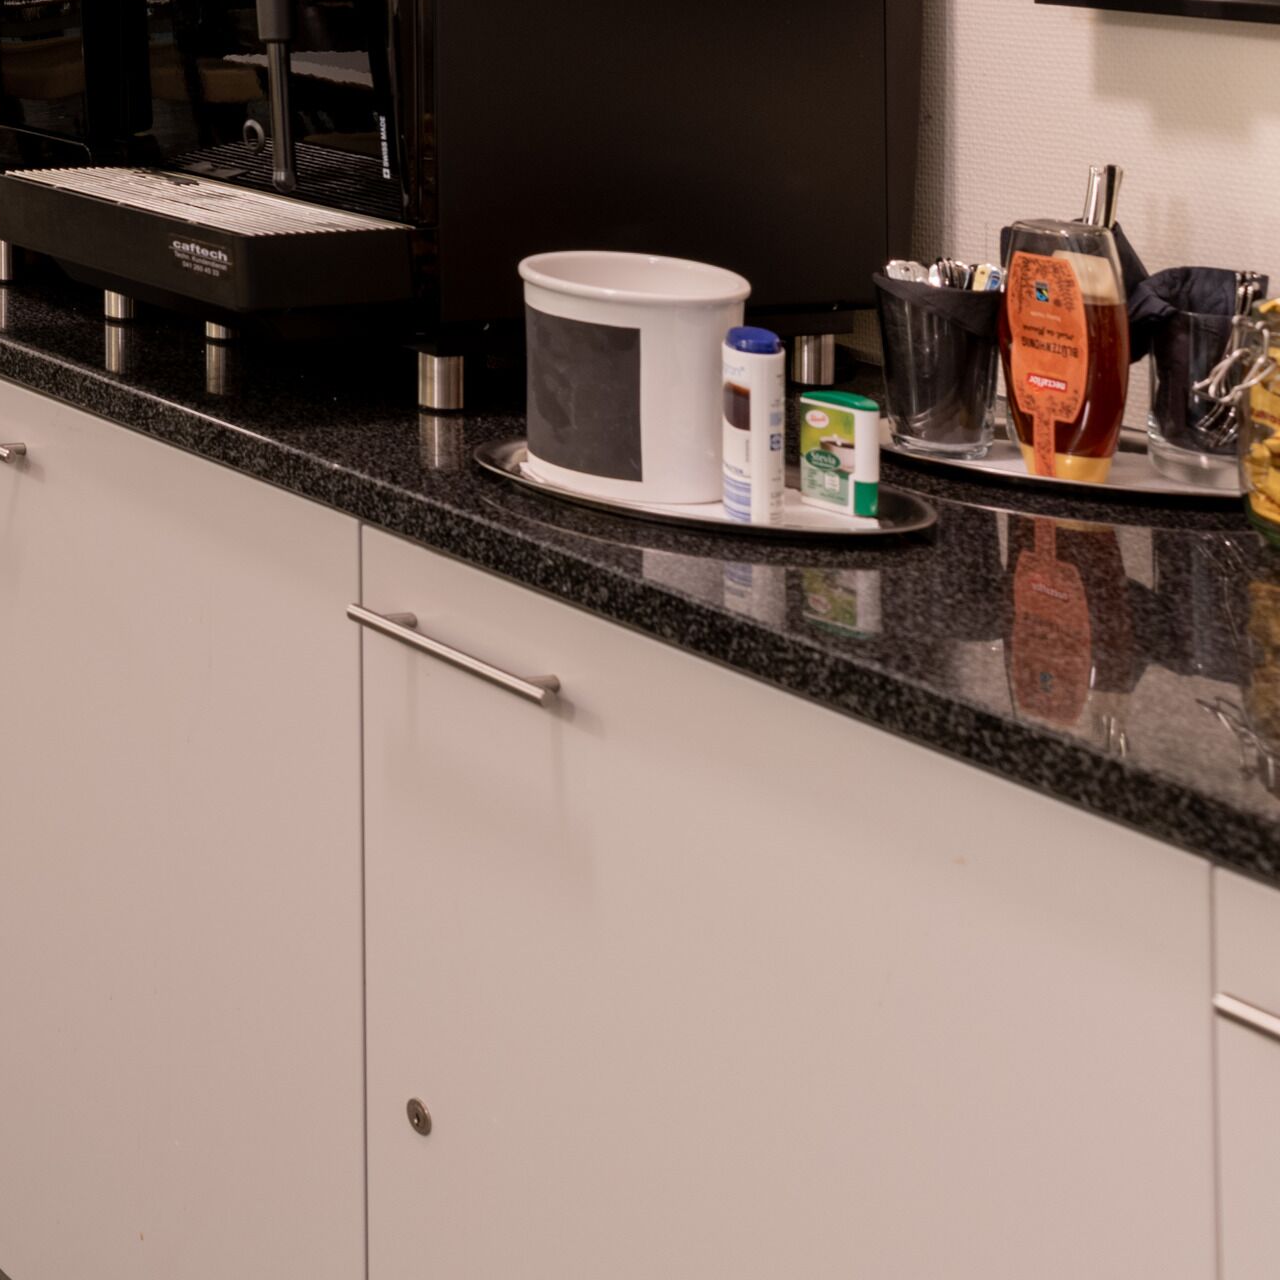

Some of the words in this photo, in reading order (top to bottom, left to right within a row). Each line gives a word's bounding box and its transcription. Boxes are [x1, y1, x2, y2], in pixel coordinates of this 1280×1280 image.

[379, 115, 387, 140] MADE
[172, 240, 228, 262] caftech
[1021, 335, 1080, 359] BLÜTENHONIG
